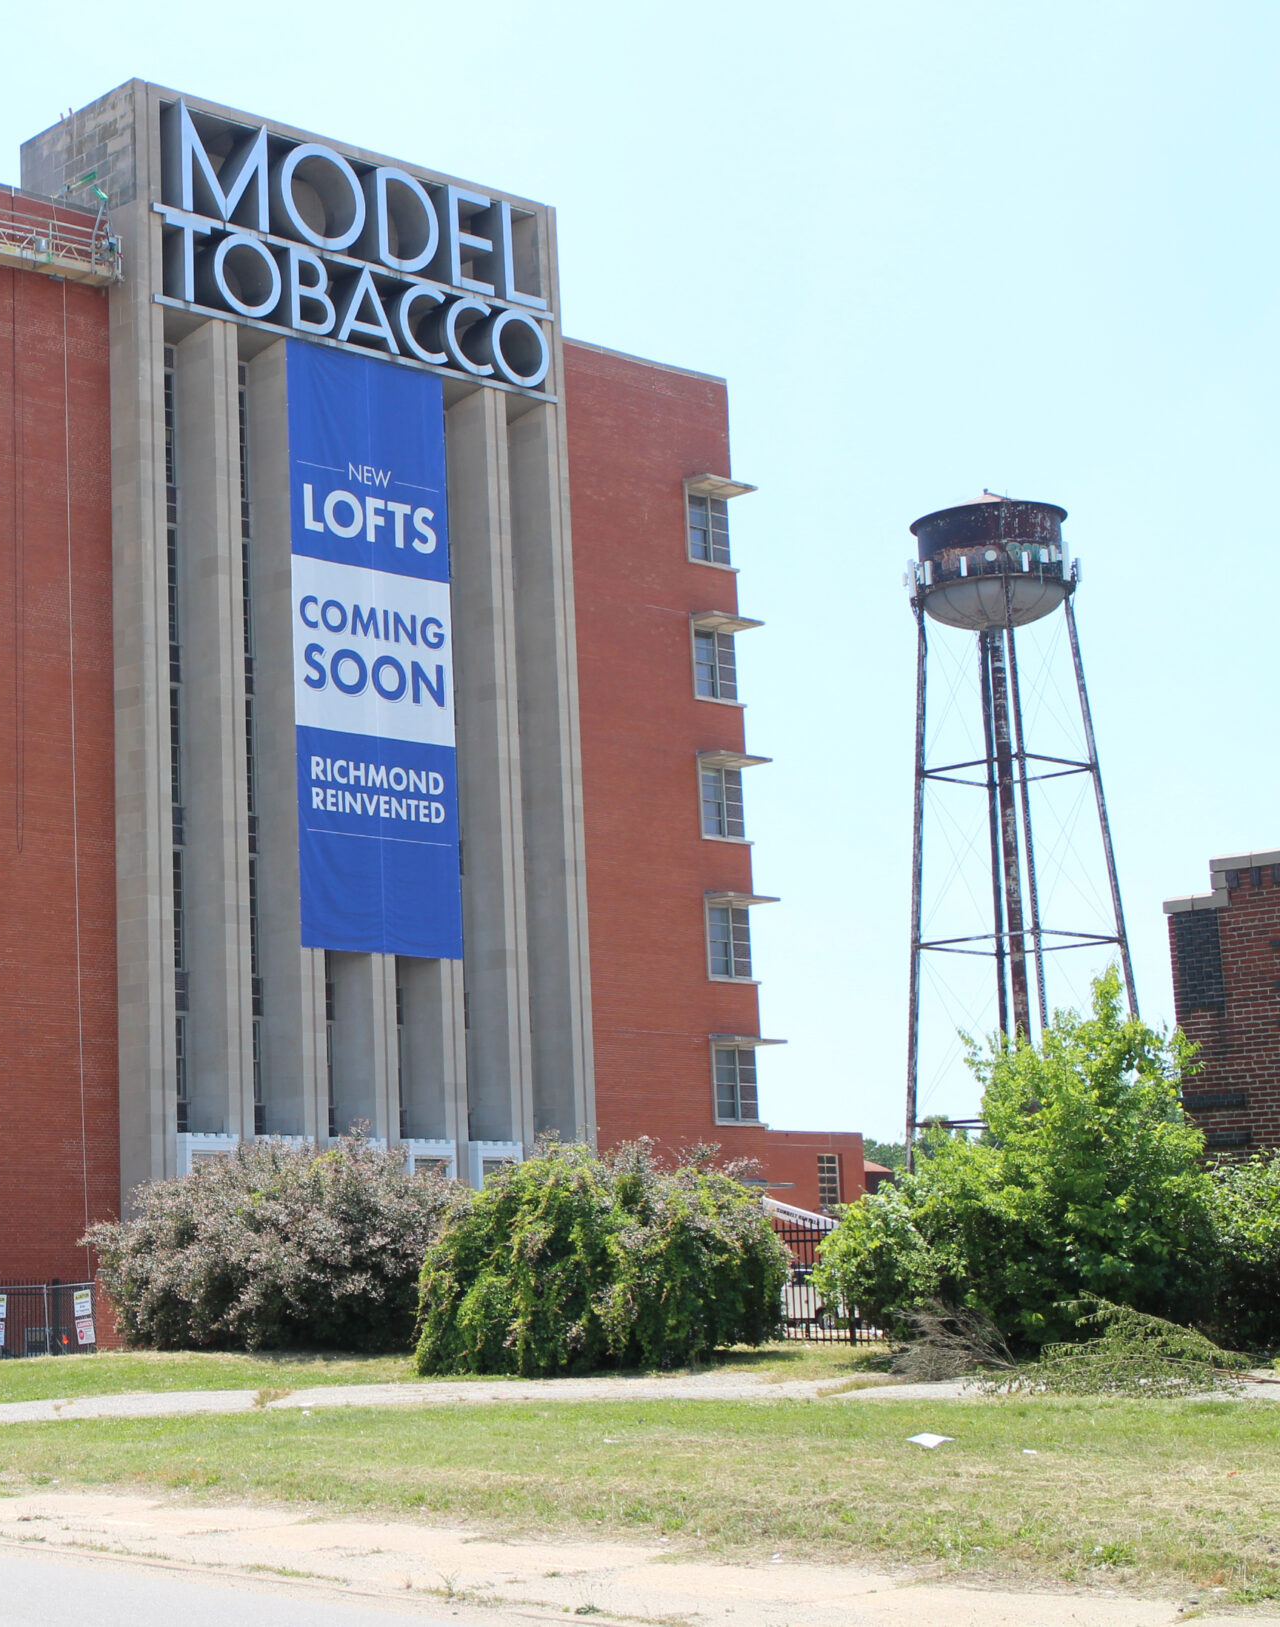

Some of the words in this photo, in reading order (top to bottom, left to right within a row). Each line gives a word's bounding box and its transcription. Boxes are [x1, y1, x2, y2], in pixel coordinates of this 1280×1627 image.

[180, 98, 547, 311] MODEL
[163, 211, 551, 388] TOBACCO
[348, 462, 392, 488] NEW
[303, 483, 437, 554] LOFTS
[299, 595, 445, 650] COMING
[303, 643, 446, 708] SOON
[310, 755, 445, 796] RICHMOND
[311, 786, 446, 824] REINVENTED
